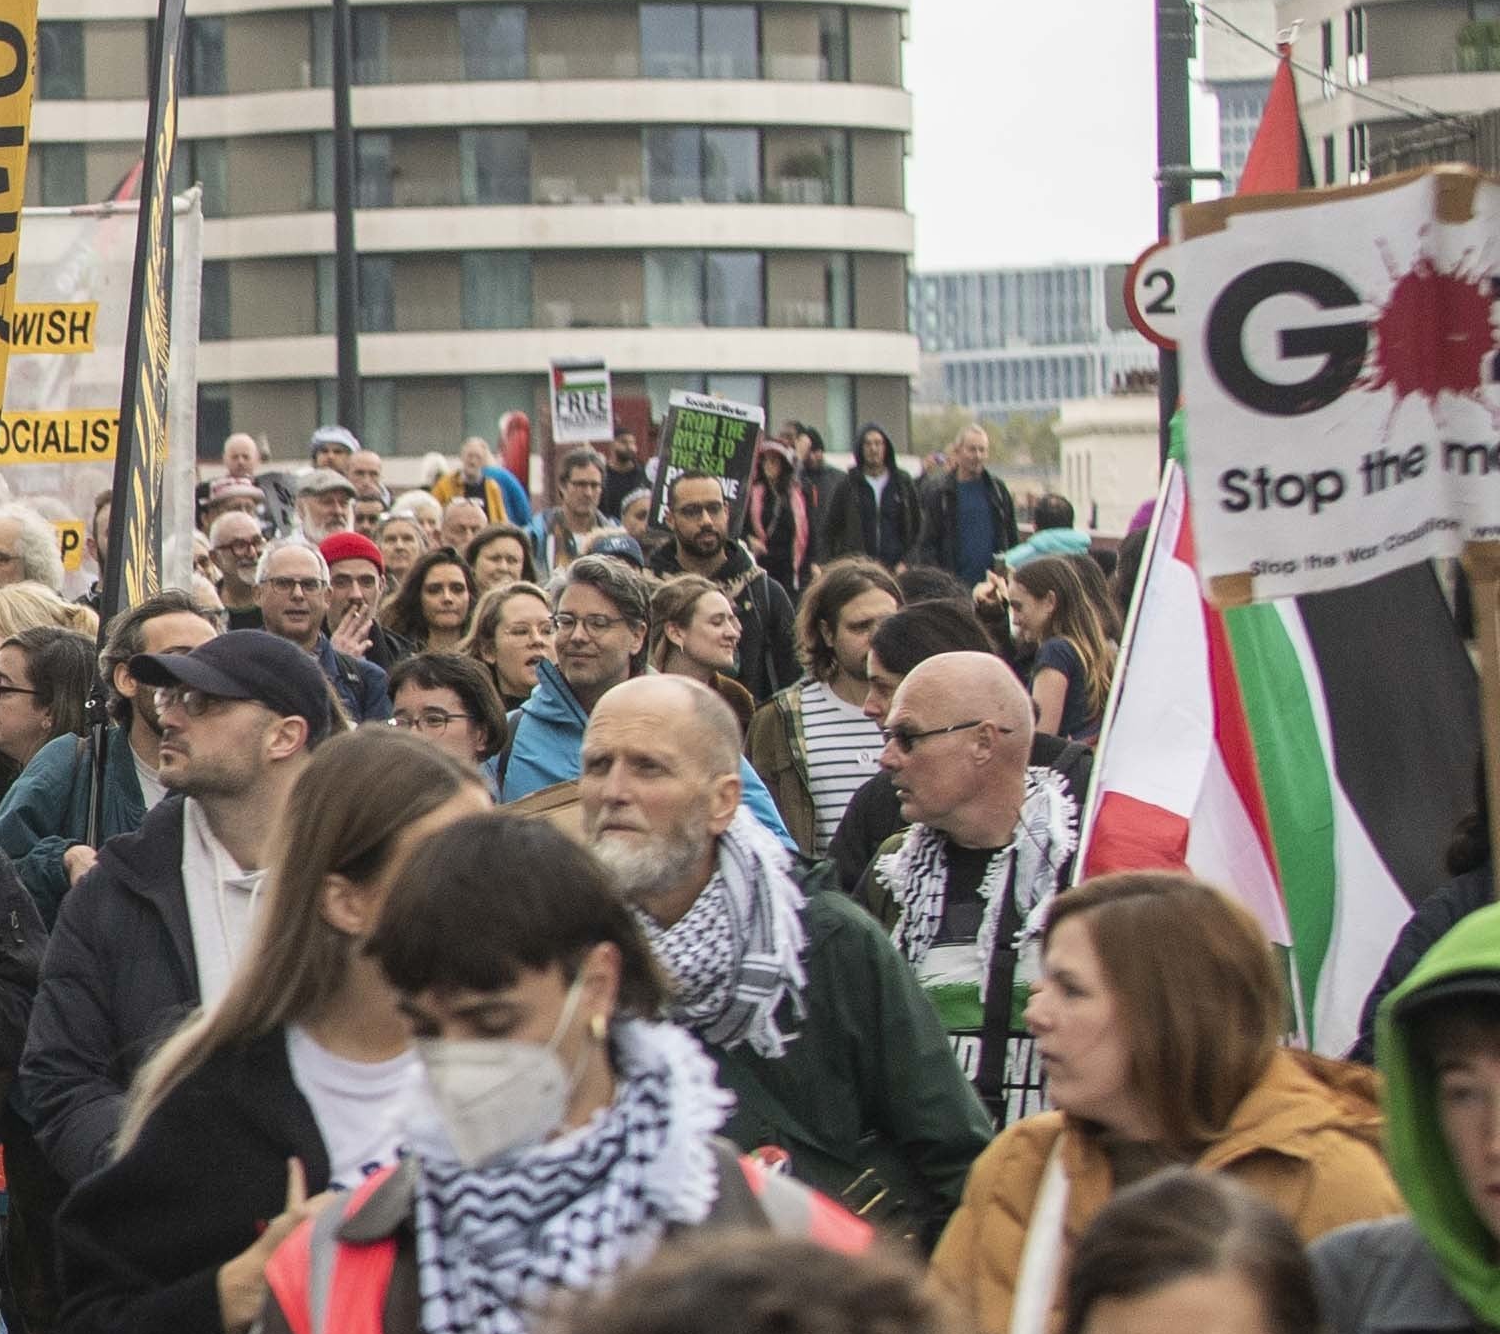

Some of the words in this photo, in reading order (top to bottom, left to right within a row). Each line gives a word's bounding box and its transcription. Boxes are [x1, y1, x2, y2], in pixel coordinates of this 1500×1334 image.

[1142, 269, 1177, 315] 2
[1218, 468, 1344, 515] Stop
[1360, 442, 1429, 496] the
[1303, 553, 1337, 570] the
